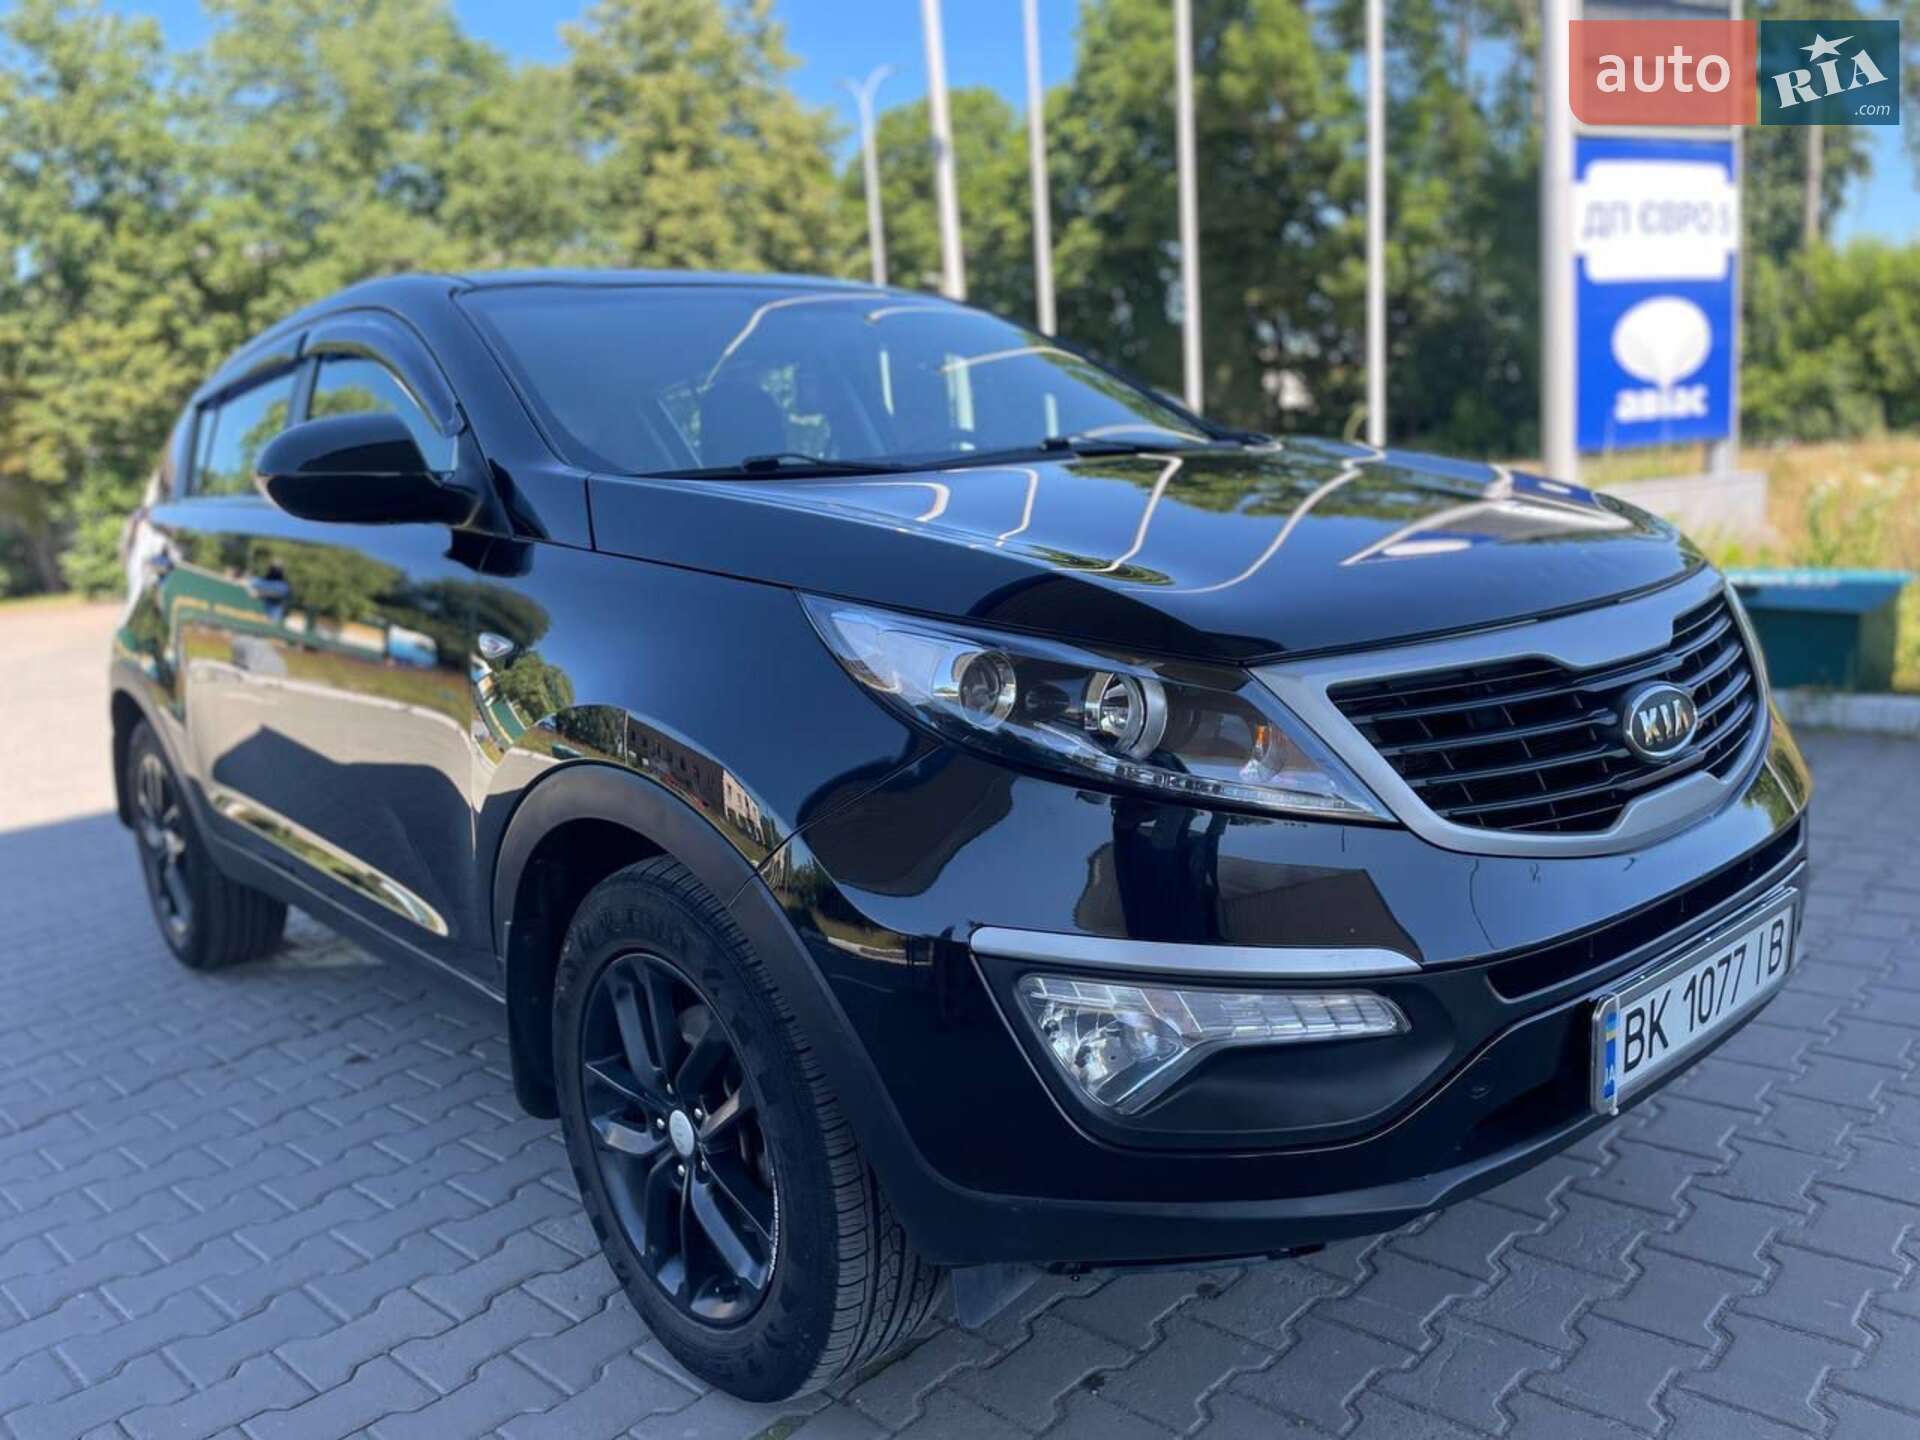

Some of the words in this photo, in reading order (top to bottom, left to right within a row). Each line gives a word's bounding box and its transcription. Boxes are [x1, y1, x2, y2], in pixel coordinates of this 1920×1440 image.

[1639, 699, 1690, 745] KIA
[1624, 989, 1670, 1073] BK
[1683, 944, 1747, 1032] 1077
